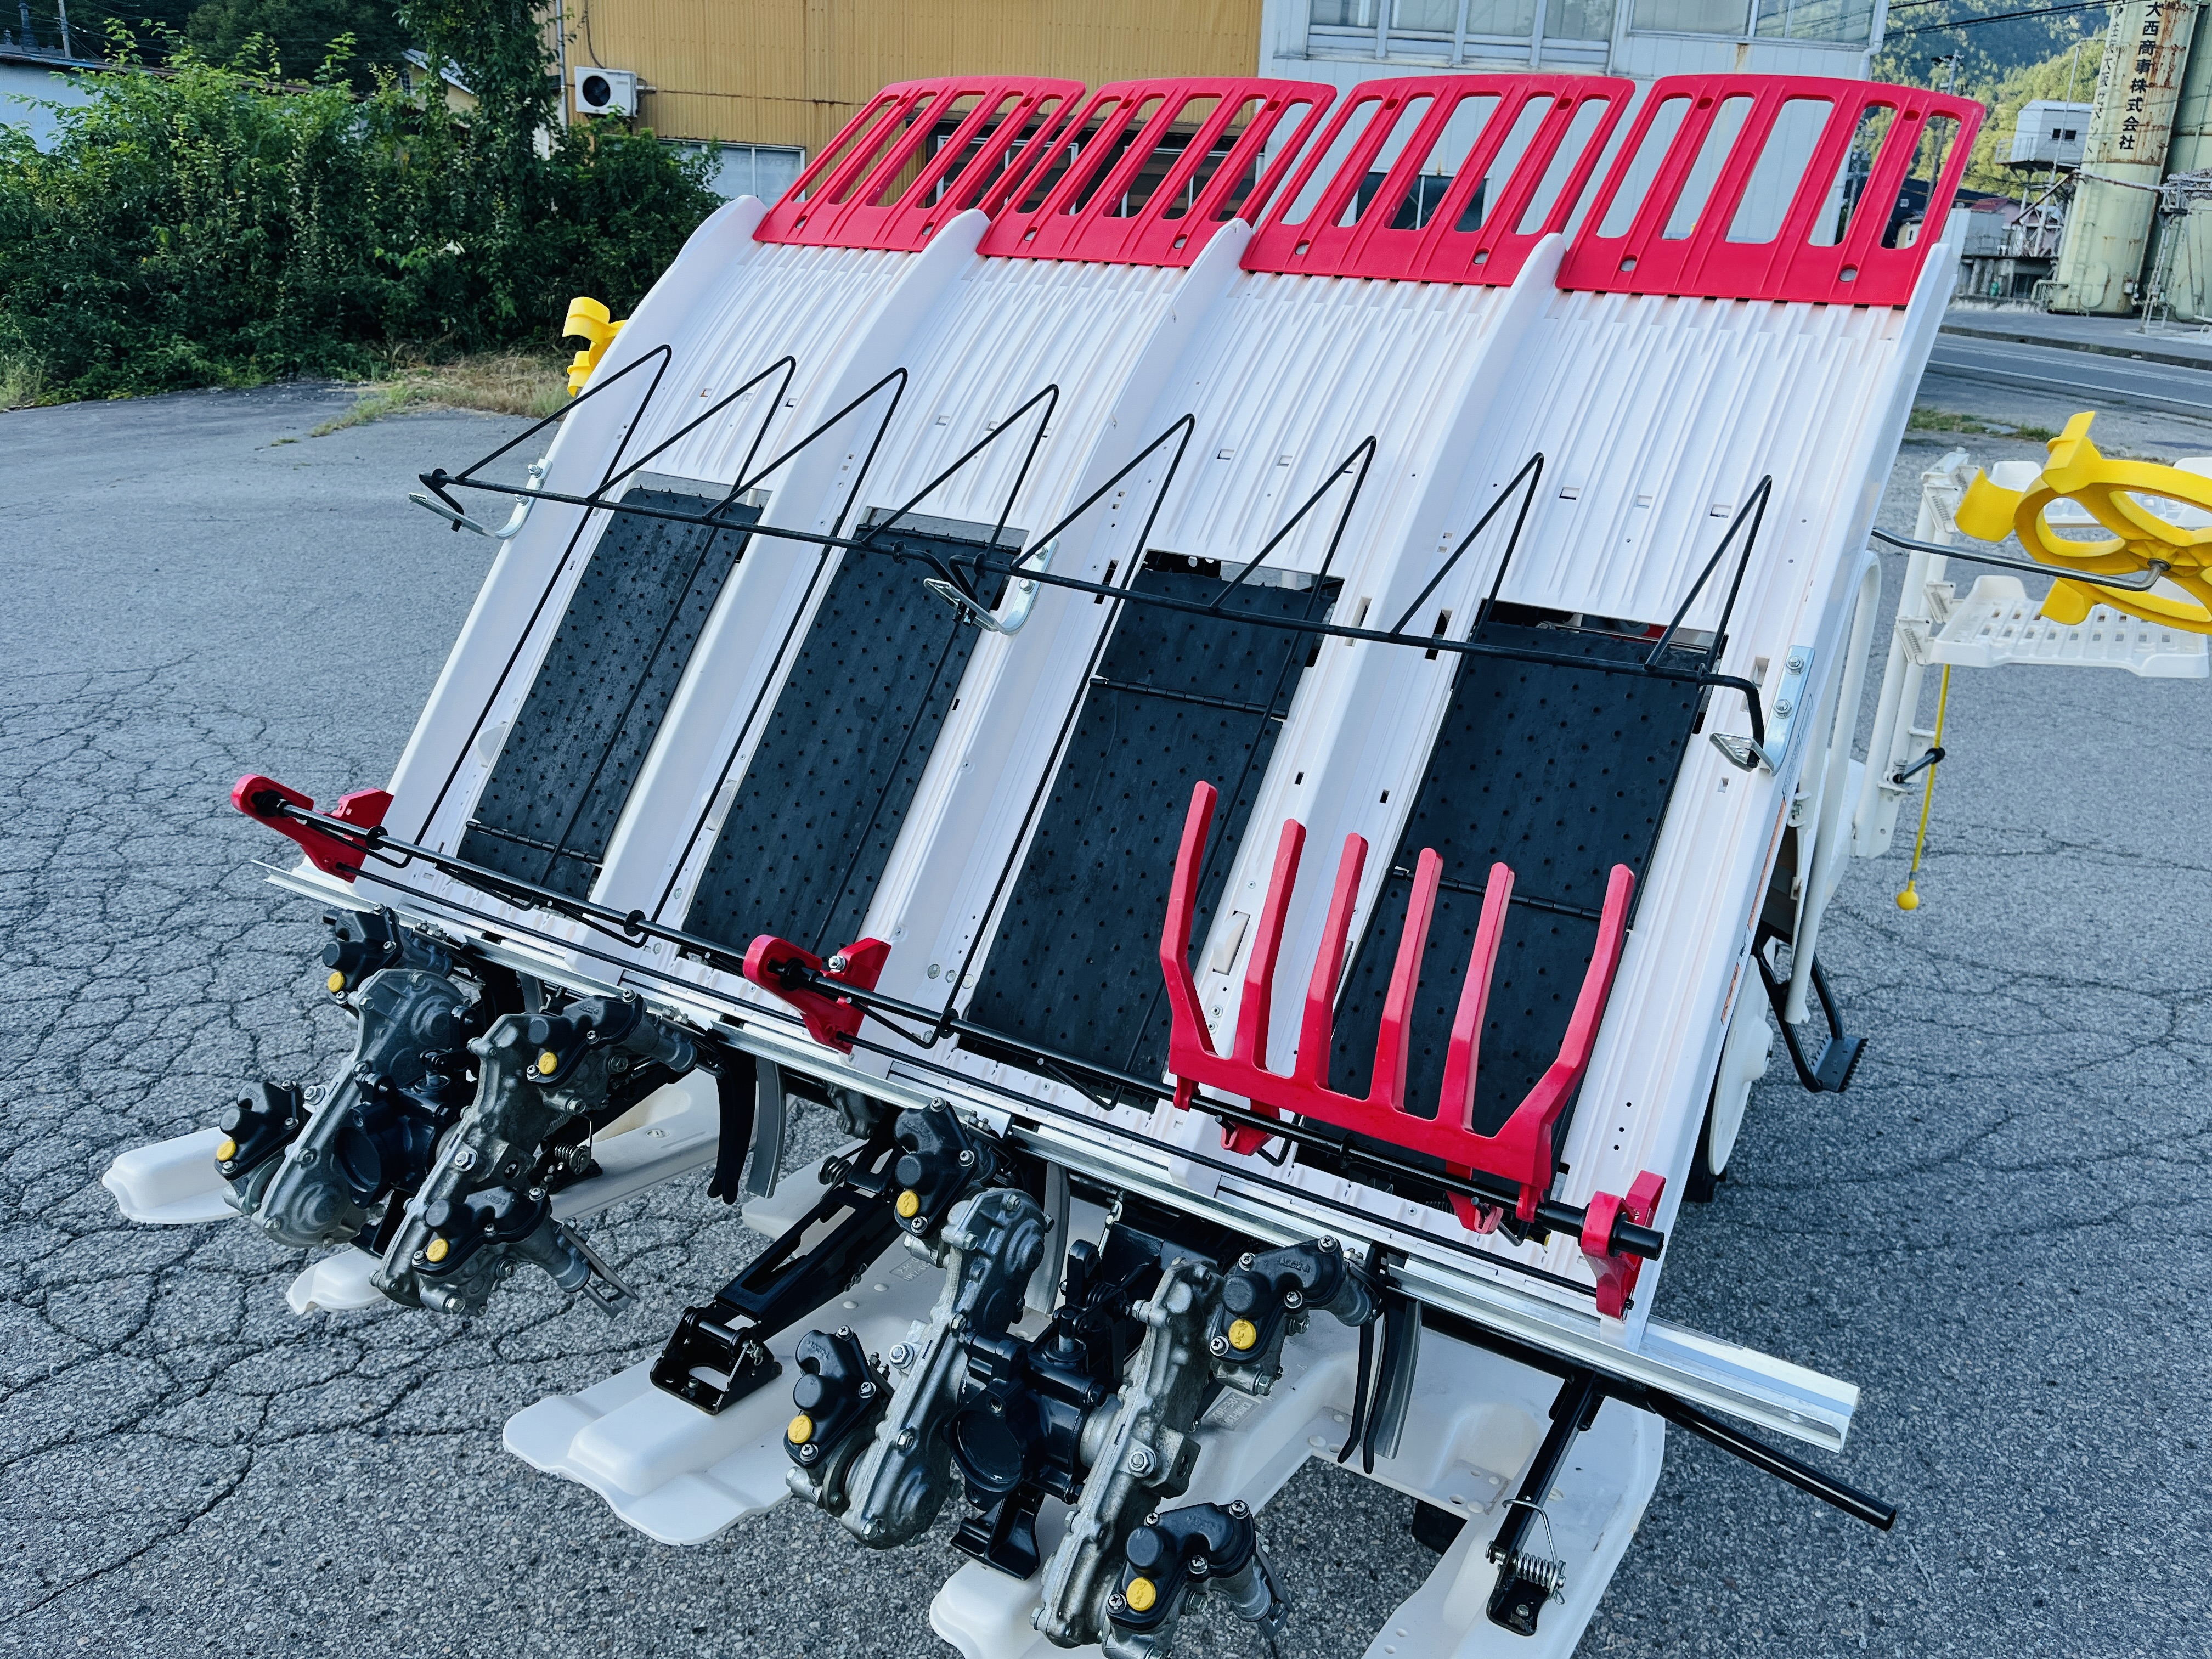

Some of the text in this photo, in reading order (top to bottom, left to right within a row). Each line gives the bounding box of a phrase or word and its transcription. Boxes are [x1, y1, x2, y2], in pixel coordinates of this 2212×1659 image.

[2118, 1, 2163, 151] 大西商事株式会社
